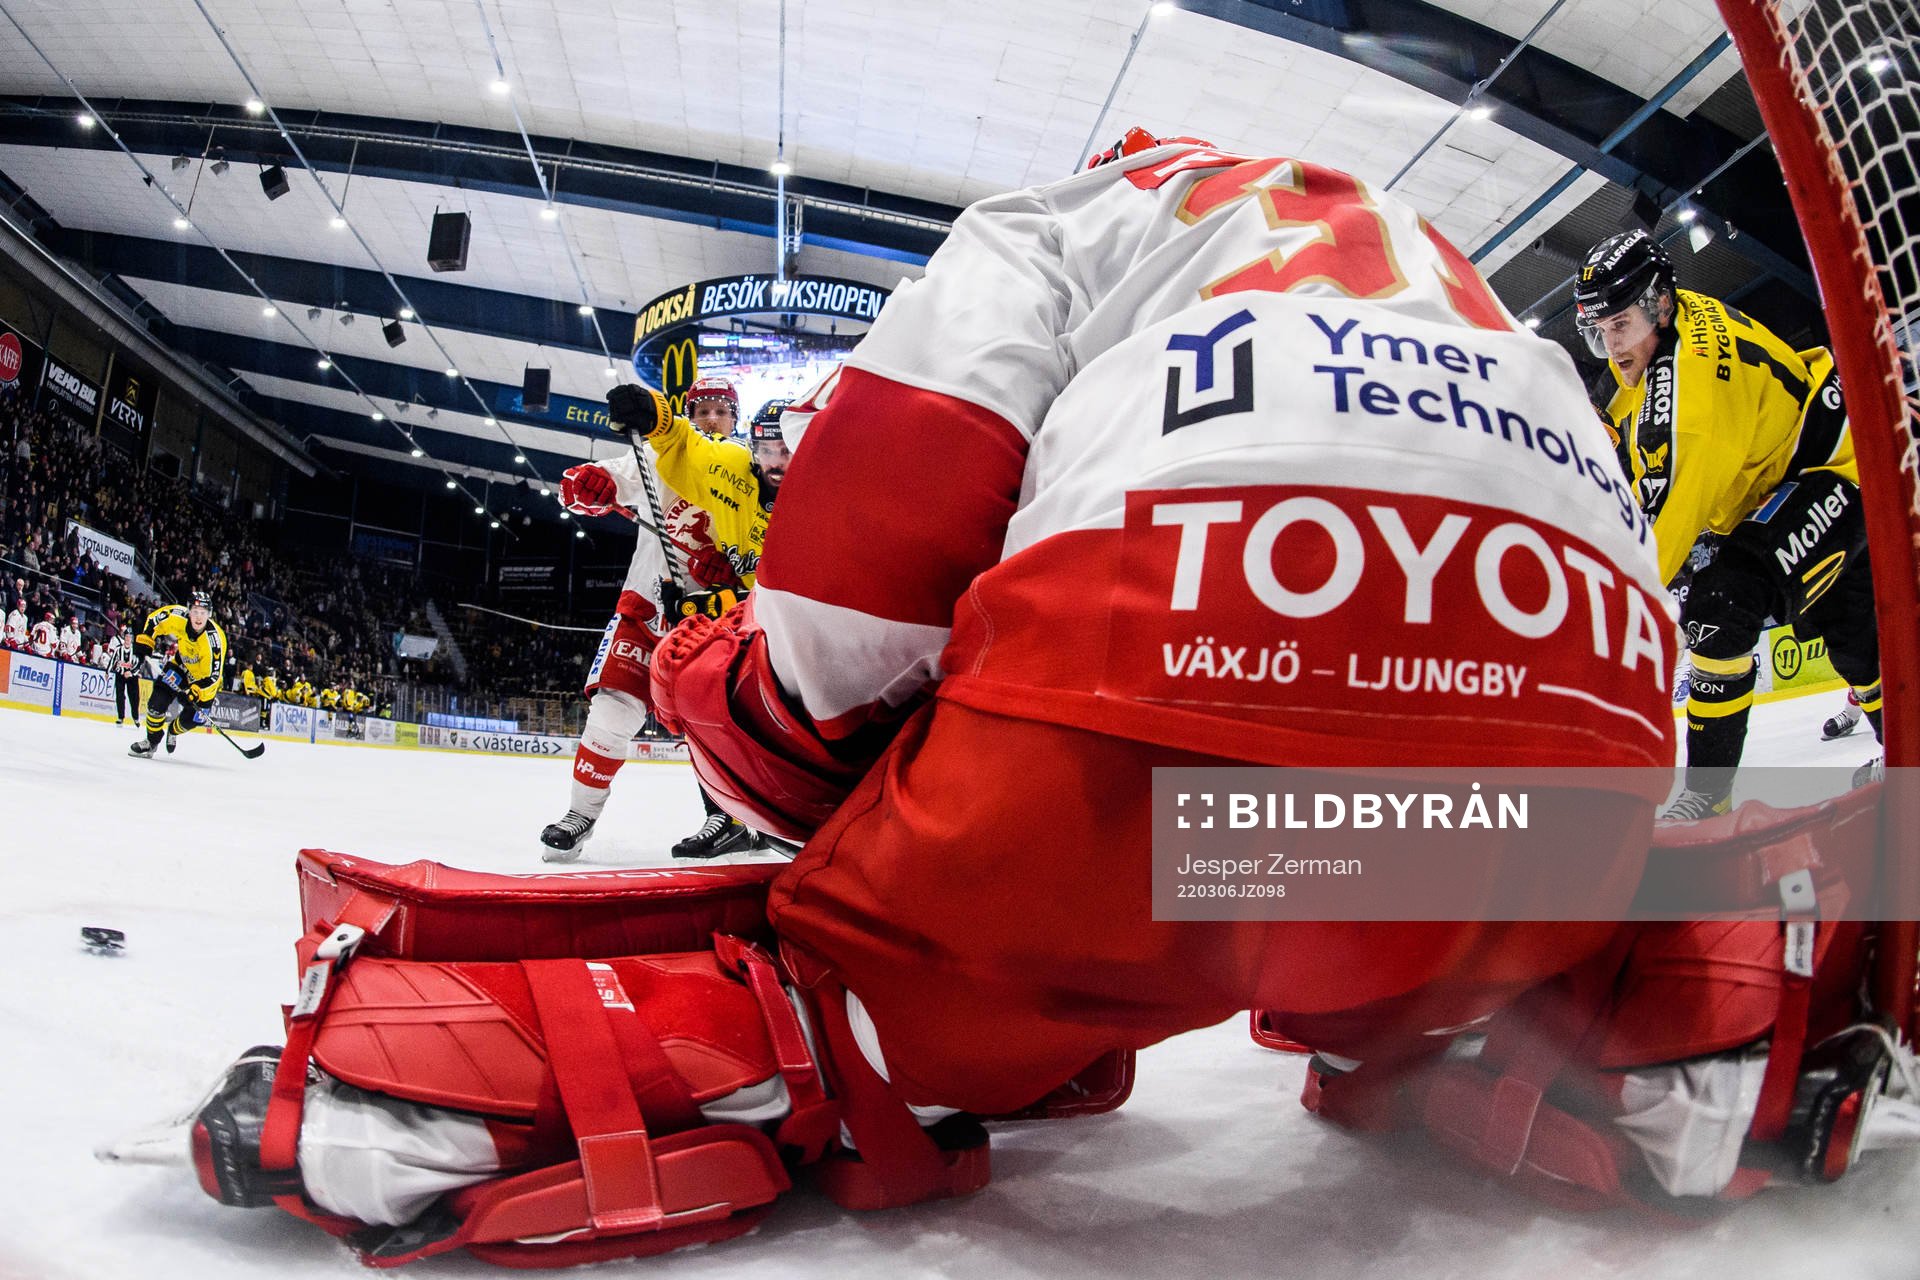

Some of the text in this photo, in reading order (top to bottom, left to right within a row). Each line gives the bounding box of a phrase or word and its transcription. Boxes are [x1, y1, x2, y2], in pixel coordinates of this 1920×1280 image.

[645, 283, 696, 334] OCKSÅ
[701, 275, 769, 315] BESÖK
[1583, 301, 1608, 312] SVENSKA
[1585, 311, 1599, 319] SPEL
[1306, 313, 1498, 382] Ymer
[1654, 366, 1672, 426] AROS
[111, 397, 144, 432] VERRY
[566, 405, 590, 423] Ett
[1313, 365, 1648, 546] Technology
[708, 463, 756, 498] LF INVEST
[1641, 478, 1668, 509] 17
[82, 536, 133, 566] TOTALBYGGEN
[1151, 495, 1667, 694] TOYOTA
[18, 664, 50, 687] Meag
[1162, 636, 1301, 685] VÄXJÖ
[1347, 652, 1527, 698] LJUNGBY
[285, 708, 308, 725] GEMA
